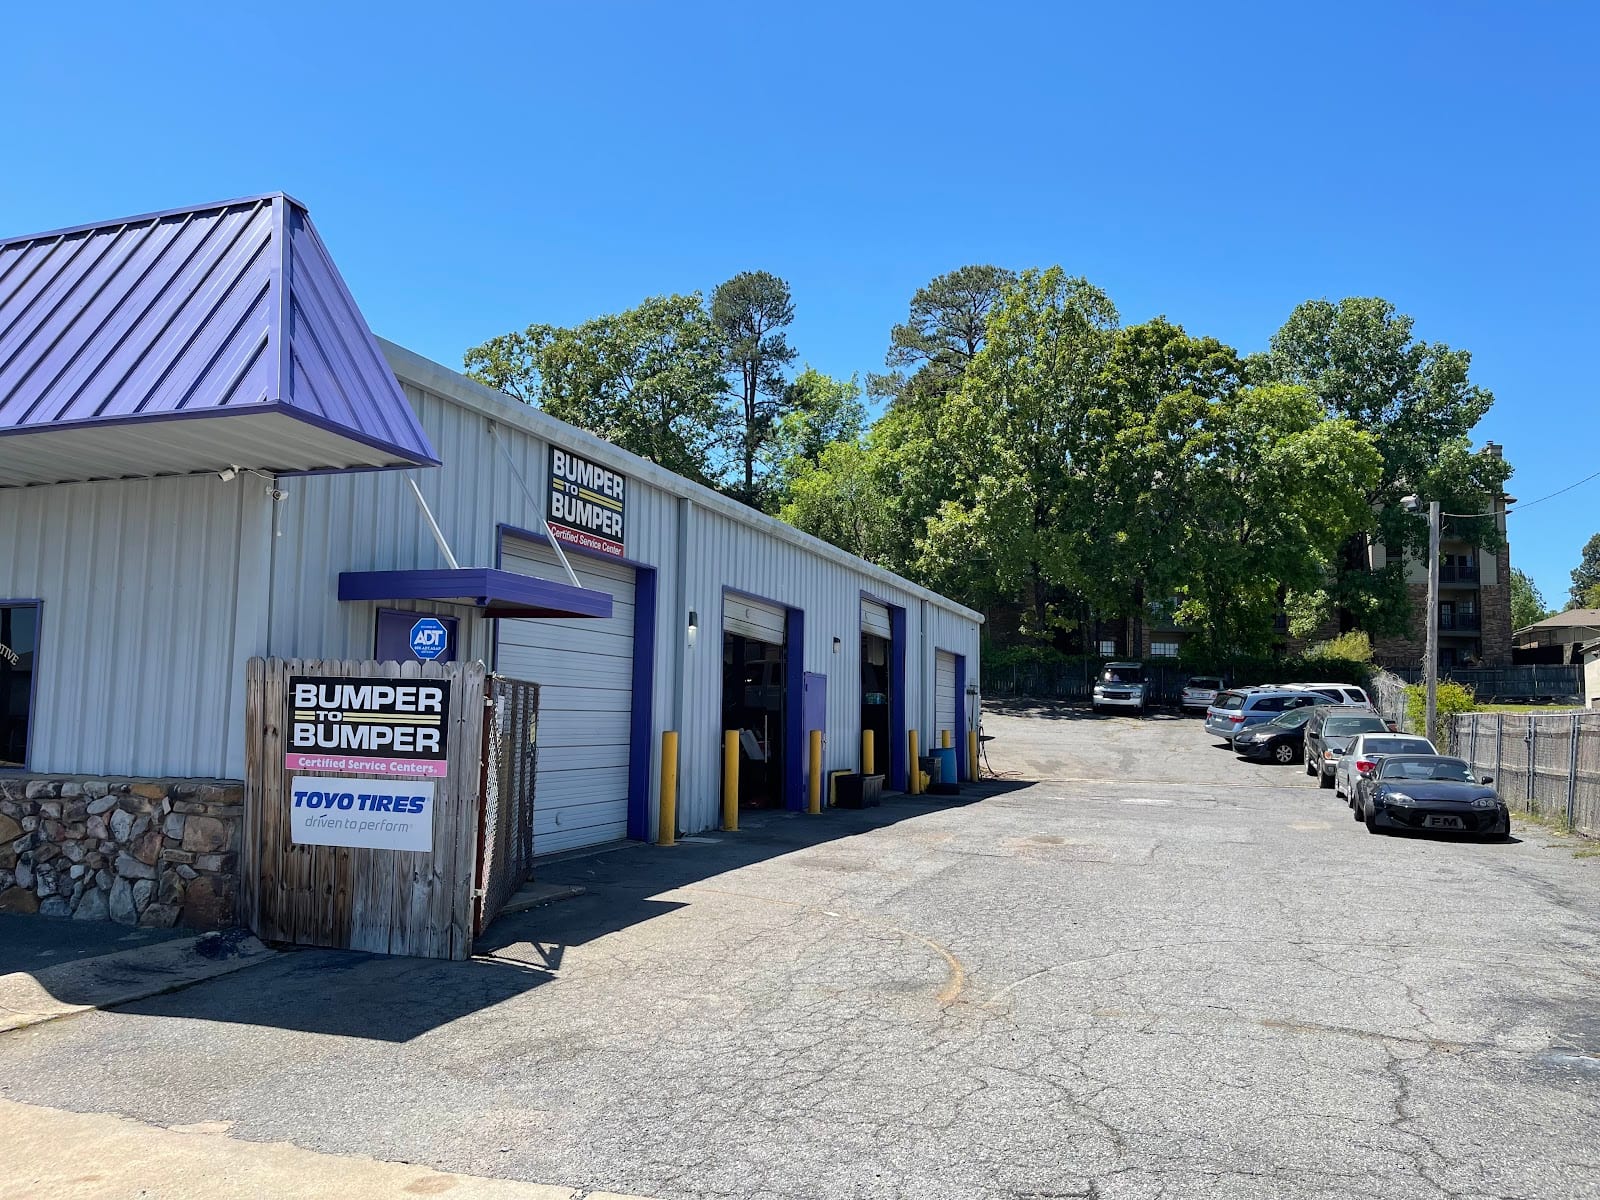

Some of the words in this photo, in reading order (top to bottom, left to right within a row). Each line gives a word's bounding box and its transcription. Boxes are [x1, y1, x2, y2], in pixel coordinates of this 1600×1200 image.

[553, 450, 623, 500] BUMPER
[565, 482, 578, 495] TO
[552, 492, 622, 537] BUMPER
[551, 526, 579, 543] Certified
[579, 534, 601, 549] Service
[602, 542, 622, 555] Center
[414, 630, 443, 645] ADT
[0, 643, 20, 666] TIVE
[294, 684, 443, 712] BUMPER
[316, 710, 342, 721] TO
[294, 723, 440, 752] BUMPER
[298, 757, 346, 769] Certified
[347, 760, 386, 771] Service
[294, 791, 355, 810] TOYO
[357, 794, 425, 814] TIRES
[304, 814, 343, 829] driven
[344, 817, 358, 830] to
[358, 818, 409, 833] perform
